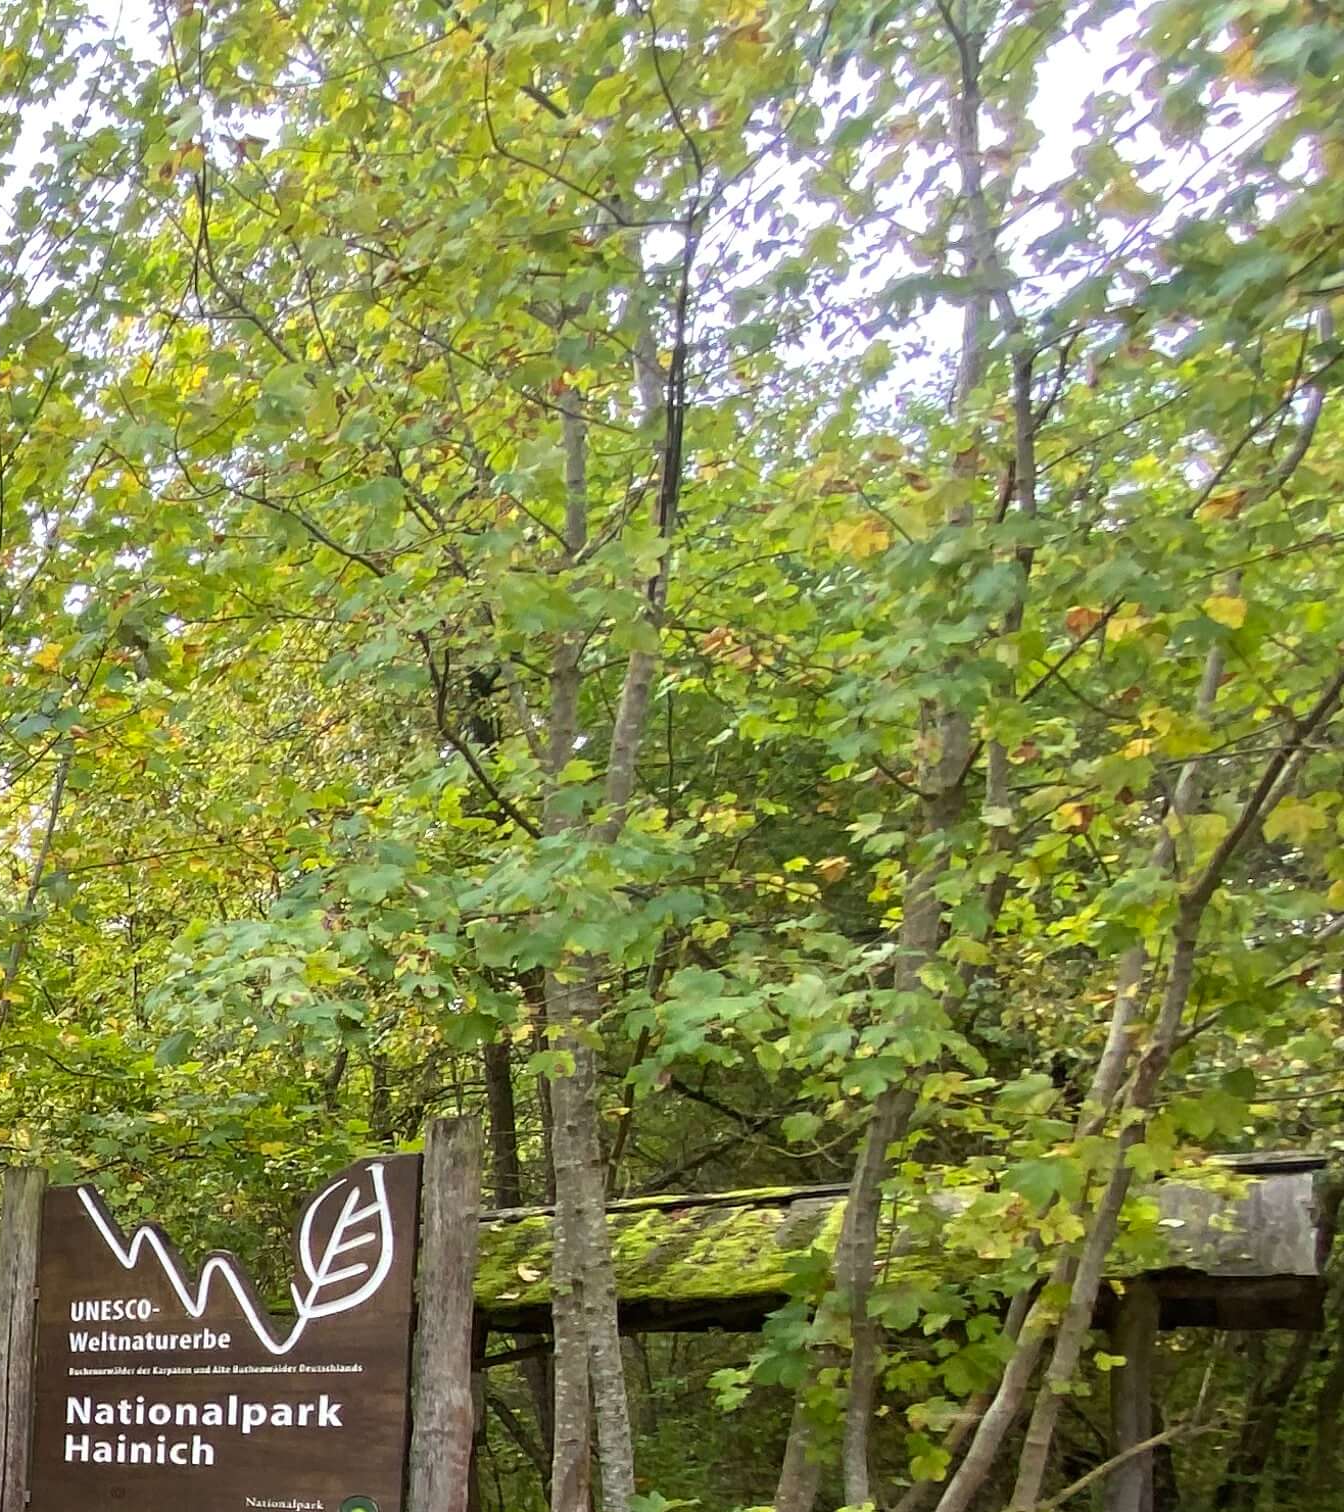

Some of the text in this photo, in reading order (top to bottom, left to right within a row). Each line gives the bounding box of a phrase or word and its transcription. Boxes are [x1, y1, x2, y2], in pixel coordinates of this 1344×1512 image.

[70, 1298, 161, 1322] UNESCO-
[69, 1327, 231, 1352] Weltnaturerbe
[136, 1366, 151, 1376] der
[152, 1365, 192, 1377] Karpaten
[193, 1365, 211, 1374] und
[212, 1364, 231, 1374] Alte
[298, 1363, 363, 1373] Deutschlands
[65, 1394, 344, 1434] Nationalpark
[63, 1434, 215, 1465] Hainich
[245, 1496, 325, 1512] Nationalpark
